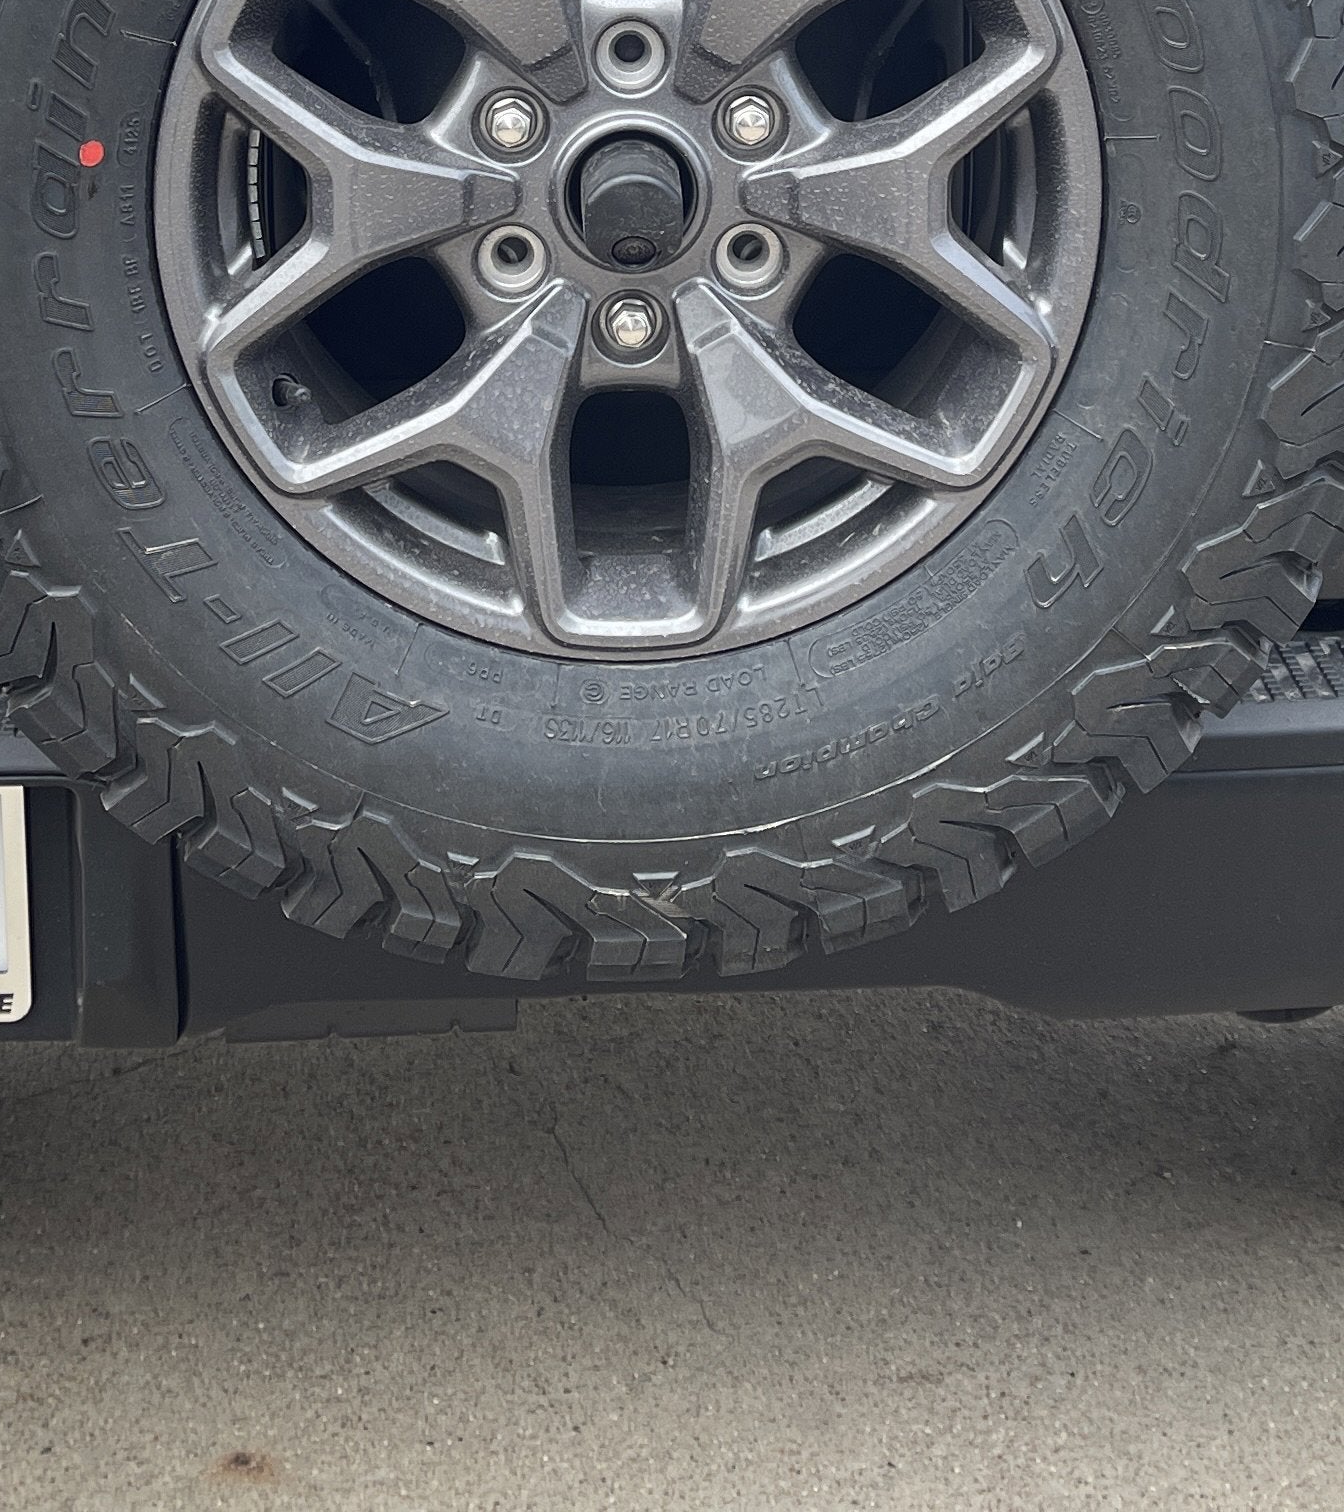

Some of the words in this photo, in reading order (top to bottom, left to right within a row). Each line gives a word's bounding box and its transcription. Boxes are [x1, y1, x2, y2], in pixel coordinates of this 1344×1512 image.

[618, 677, 698, 701] RANGE
[702, 662, 769, 695] LOAD
[751, 694, 942, 781] Champion
